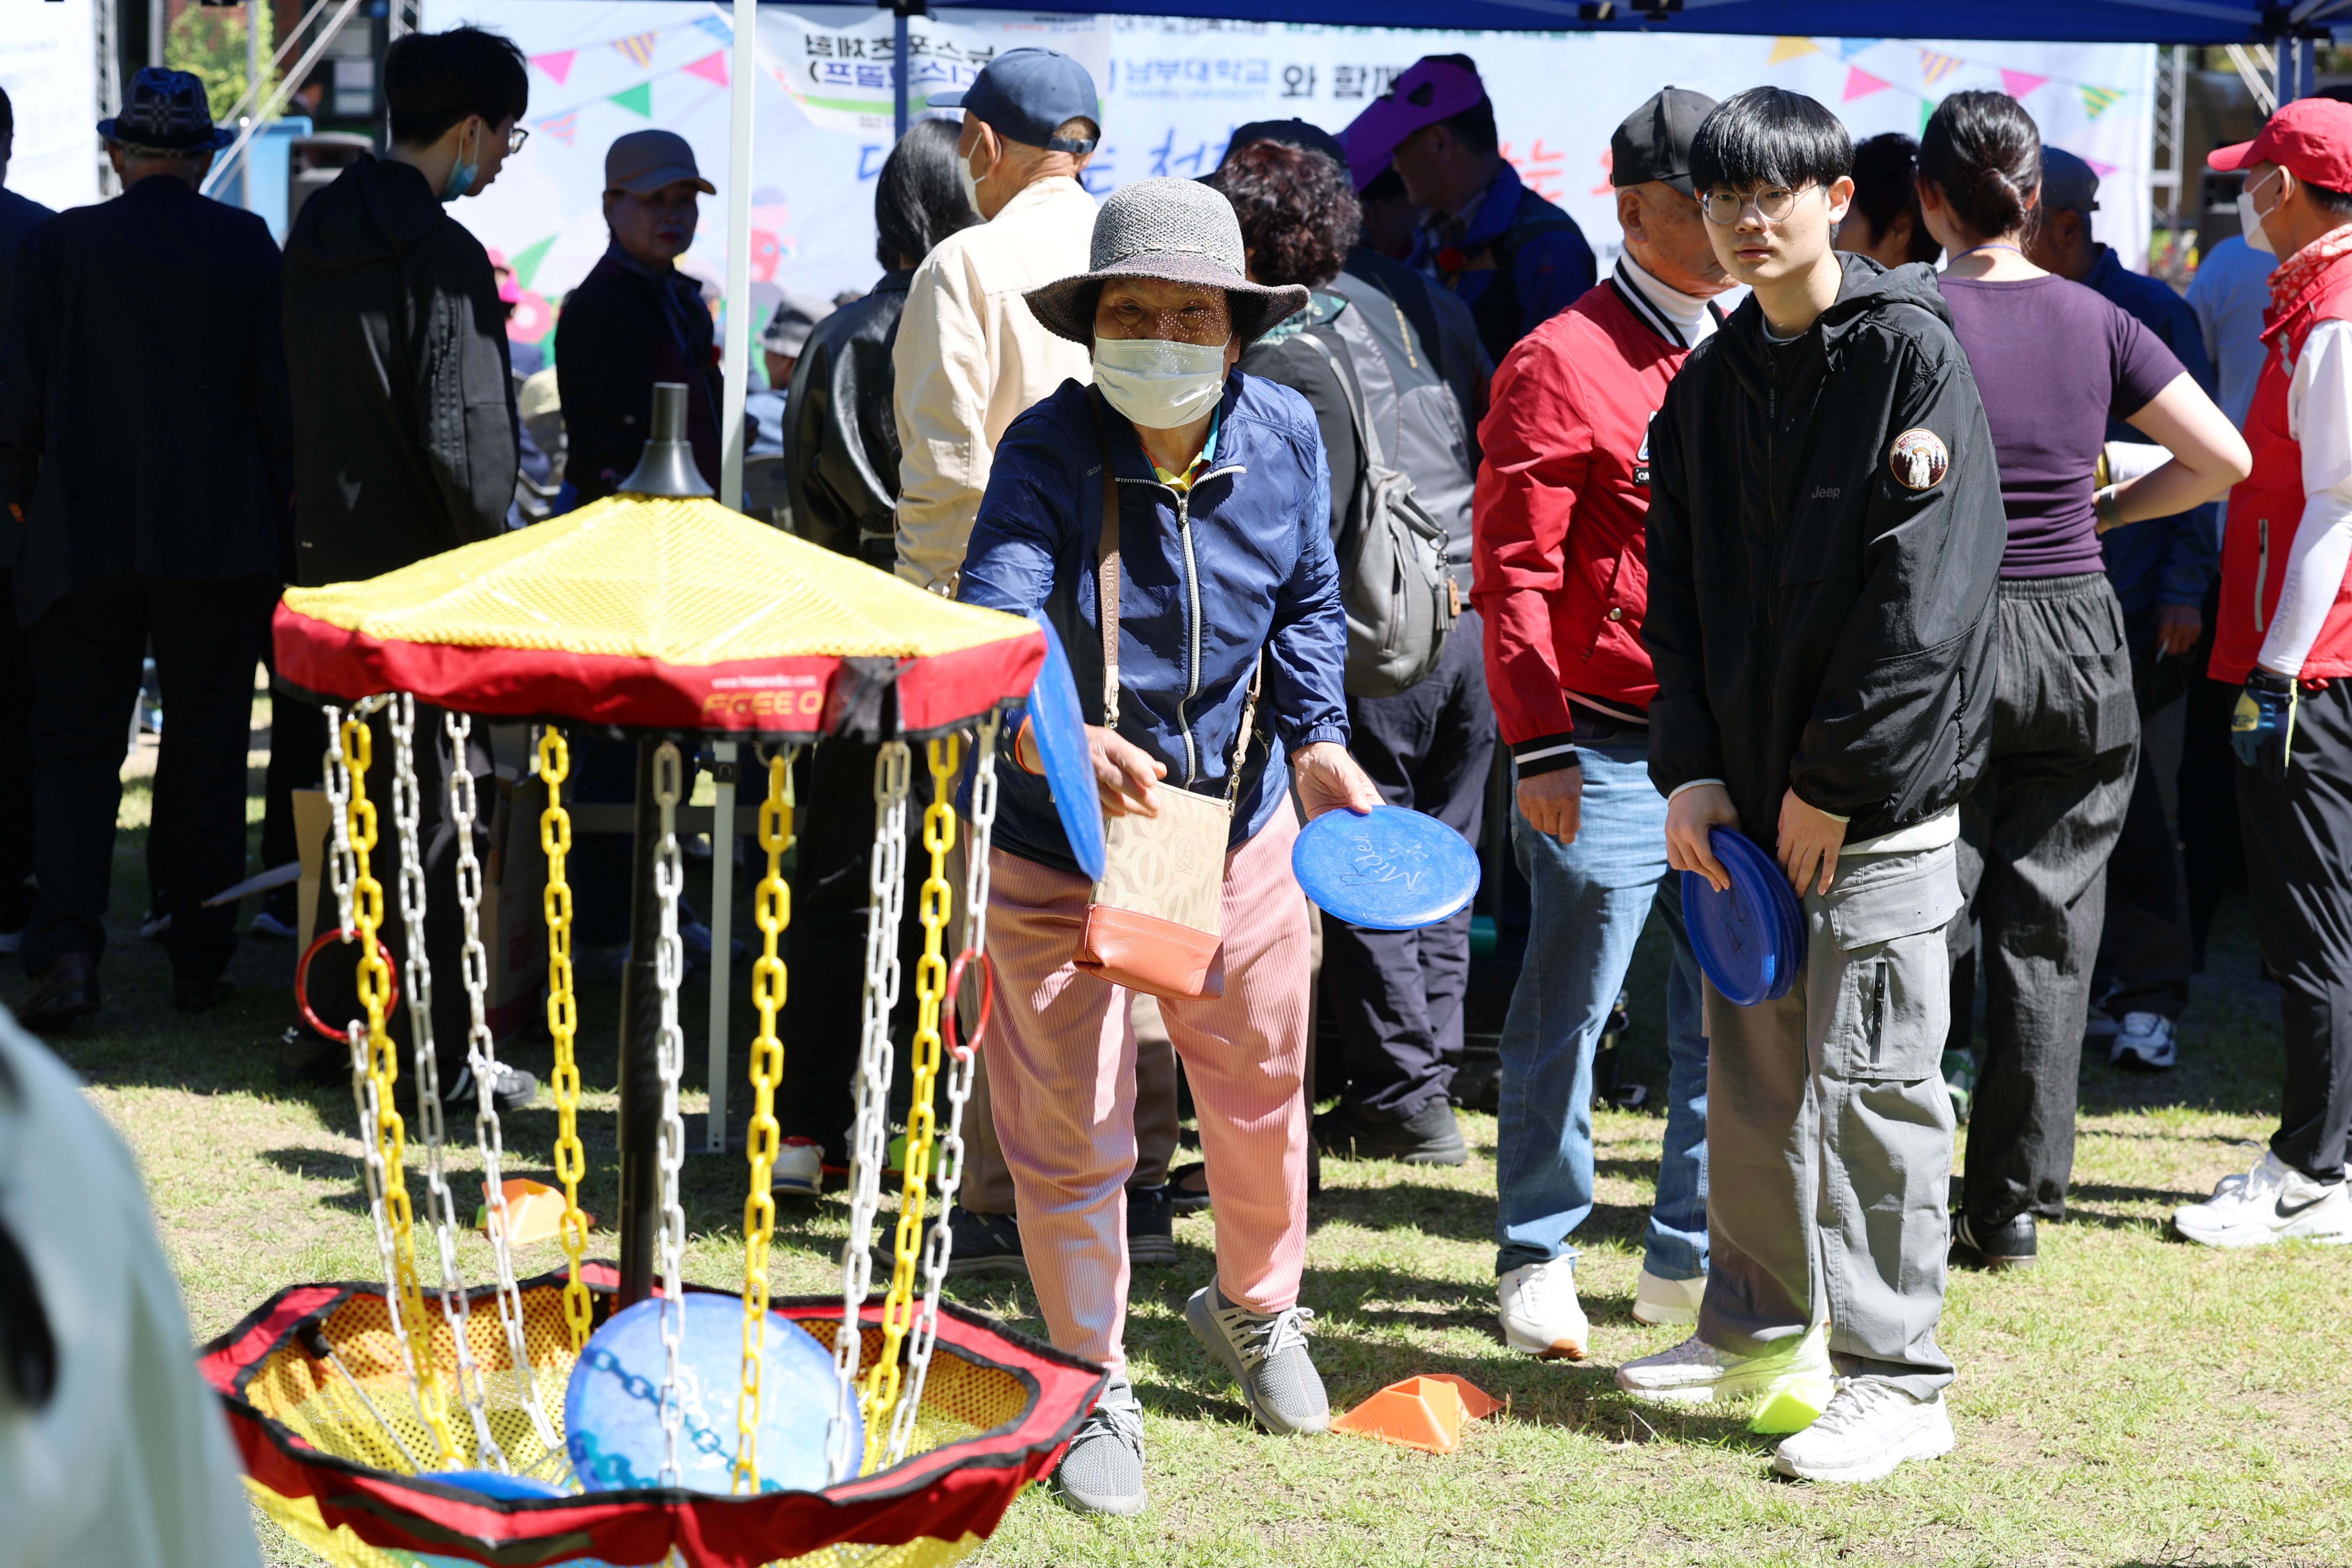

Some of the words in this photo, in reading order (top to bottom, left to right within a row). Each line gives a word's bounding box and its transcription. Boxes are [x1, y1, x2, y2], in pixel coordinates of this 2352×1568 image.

[1281, 65, 1317, 98] 와
[1811, 486, 1841, 499] Jeep
[2269, 570, 2301, 645] ELEGANCE
